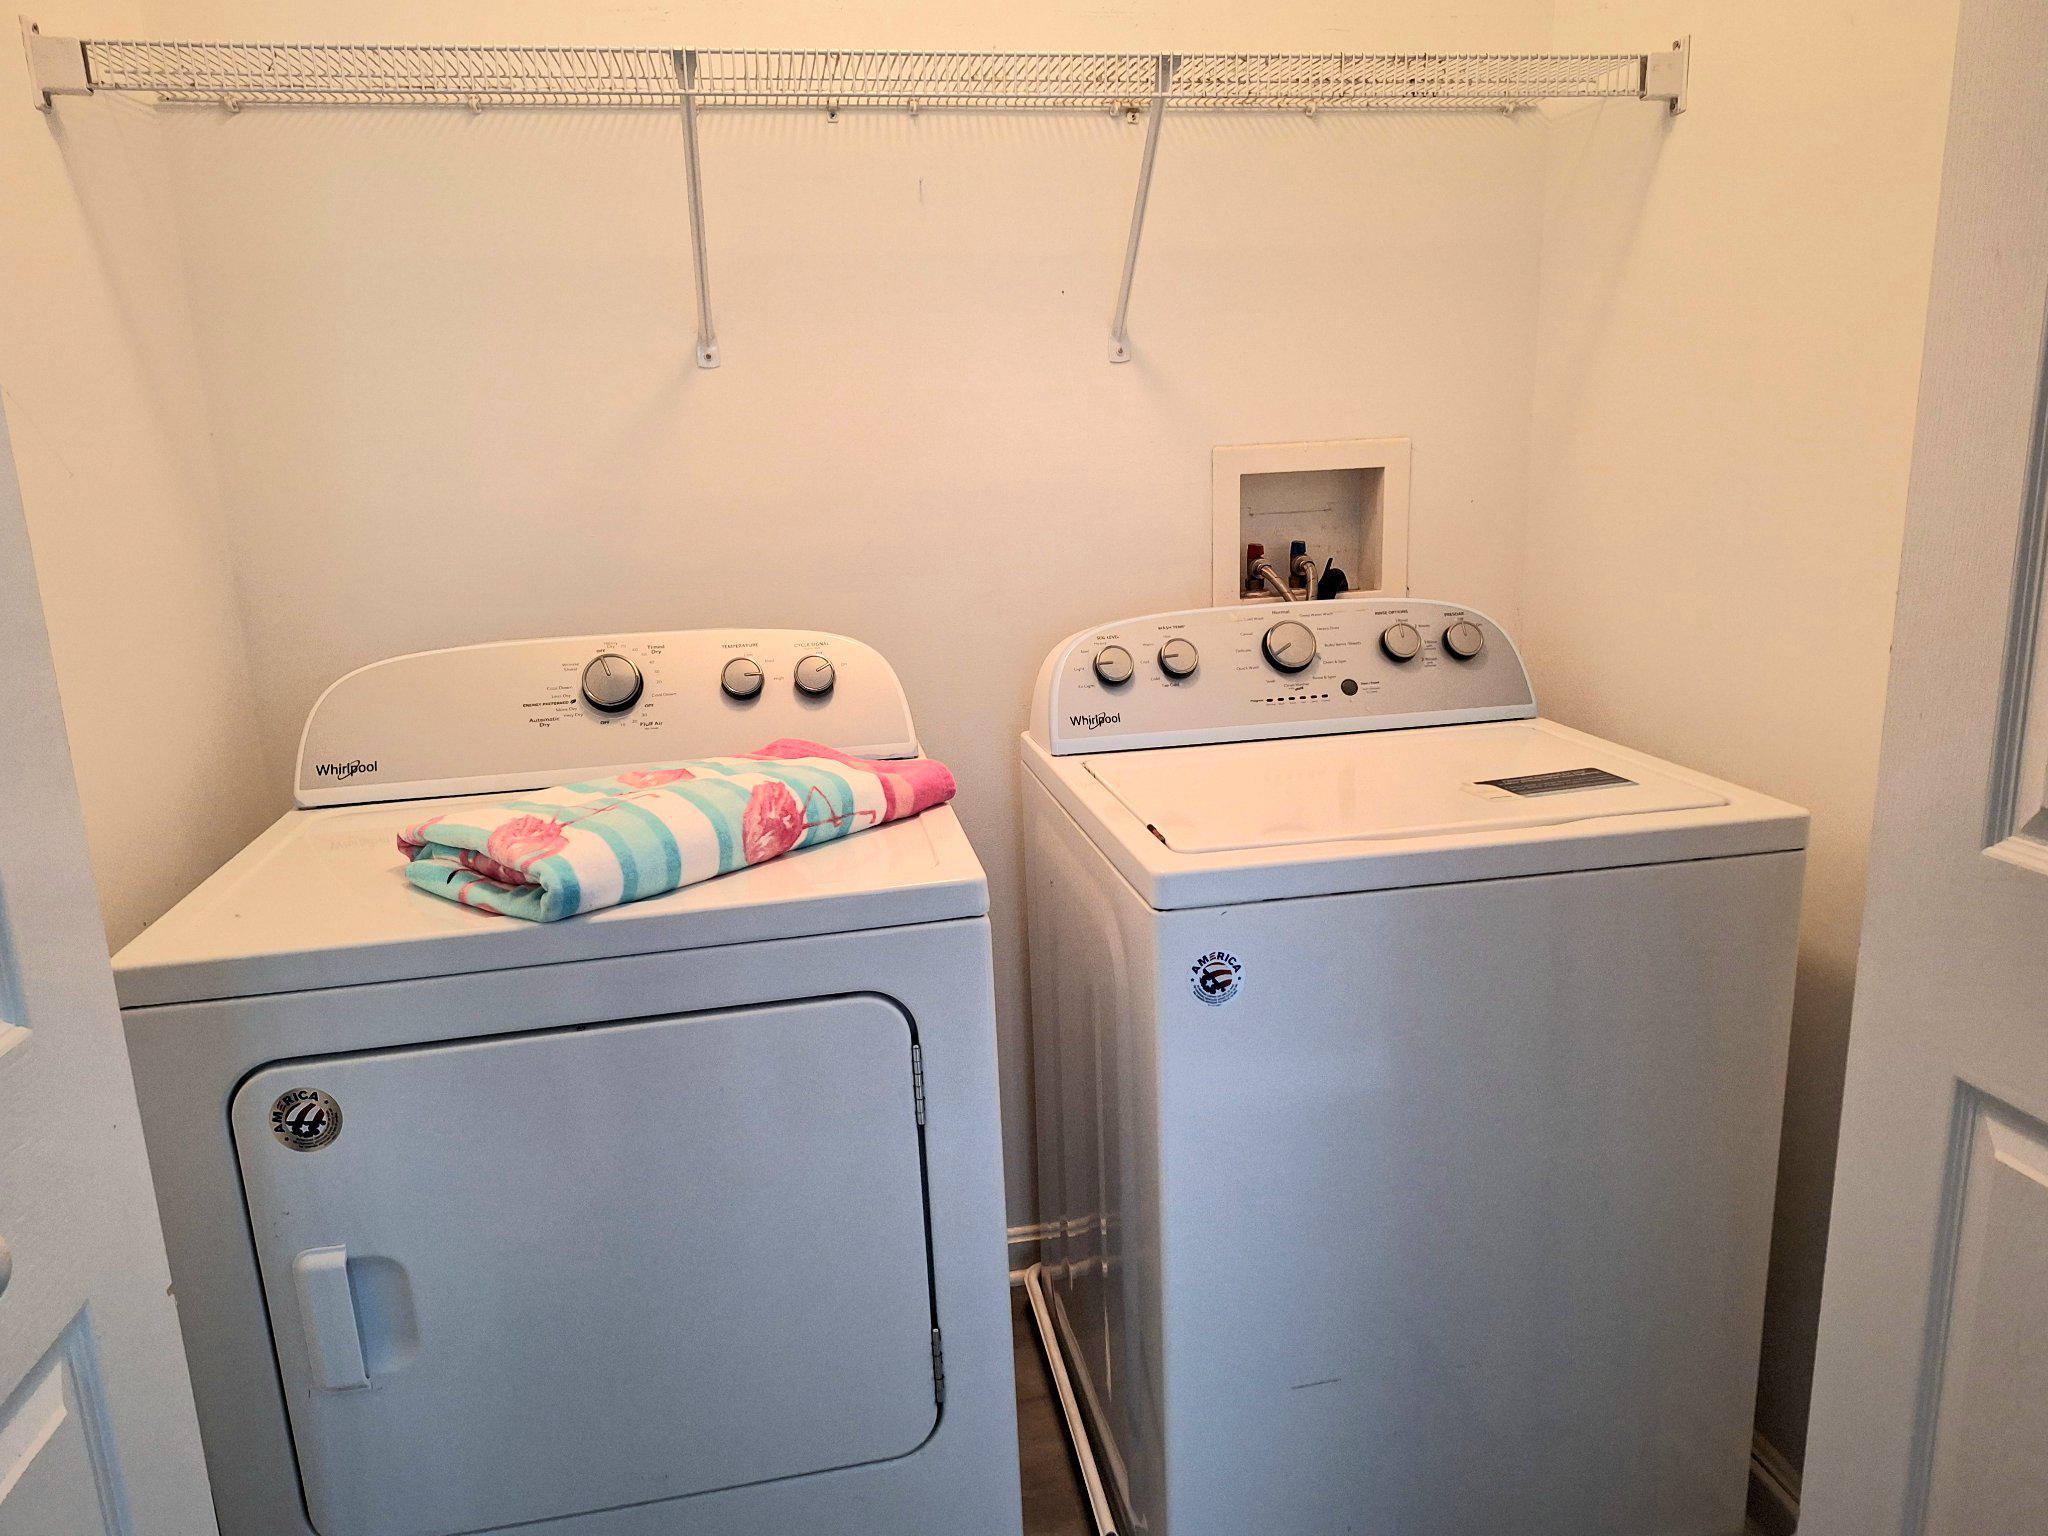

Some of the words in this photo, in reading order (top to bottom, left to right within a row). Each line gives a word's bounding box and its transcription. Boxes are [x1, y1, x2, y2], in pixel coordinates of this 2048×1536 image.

[1069, 712, 1121, 730] Whirlpool
[315, 760, 378, 780] Whirlpool
[1191, 951, 1242, 975] AMERICA
[271, 1090, 319, 1133] AMERICA
